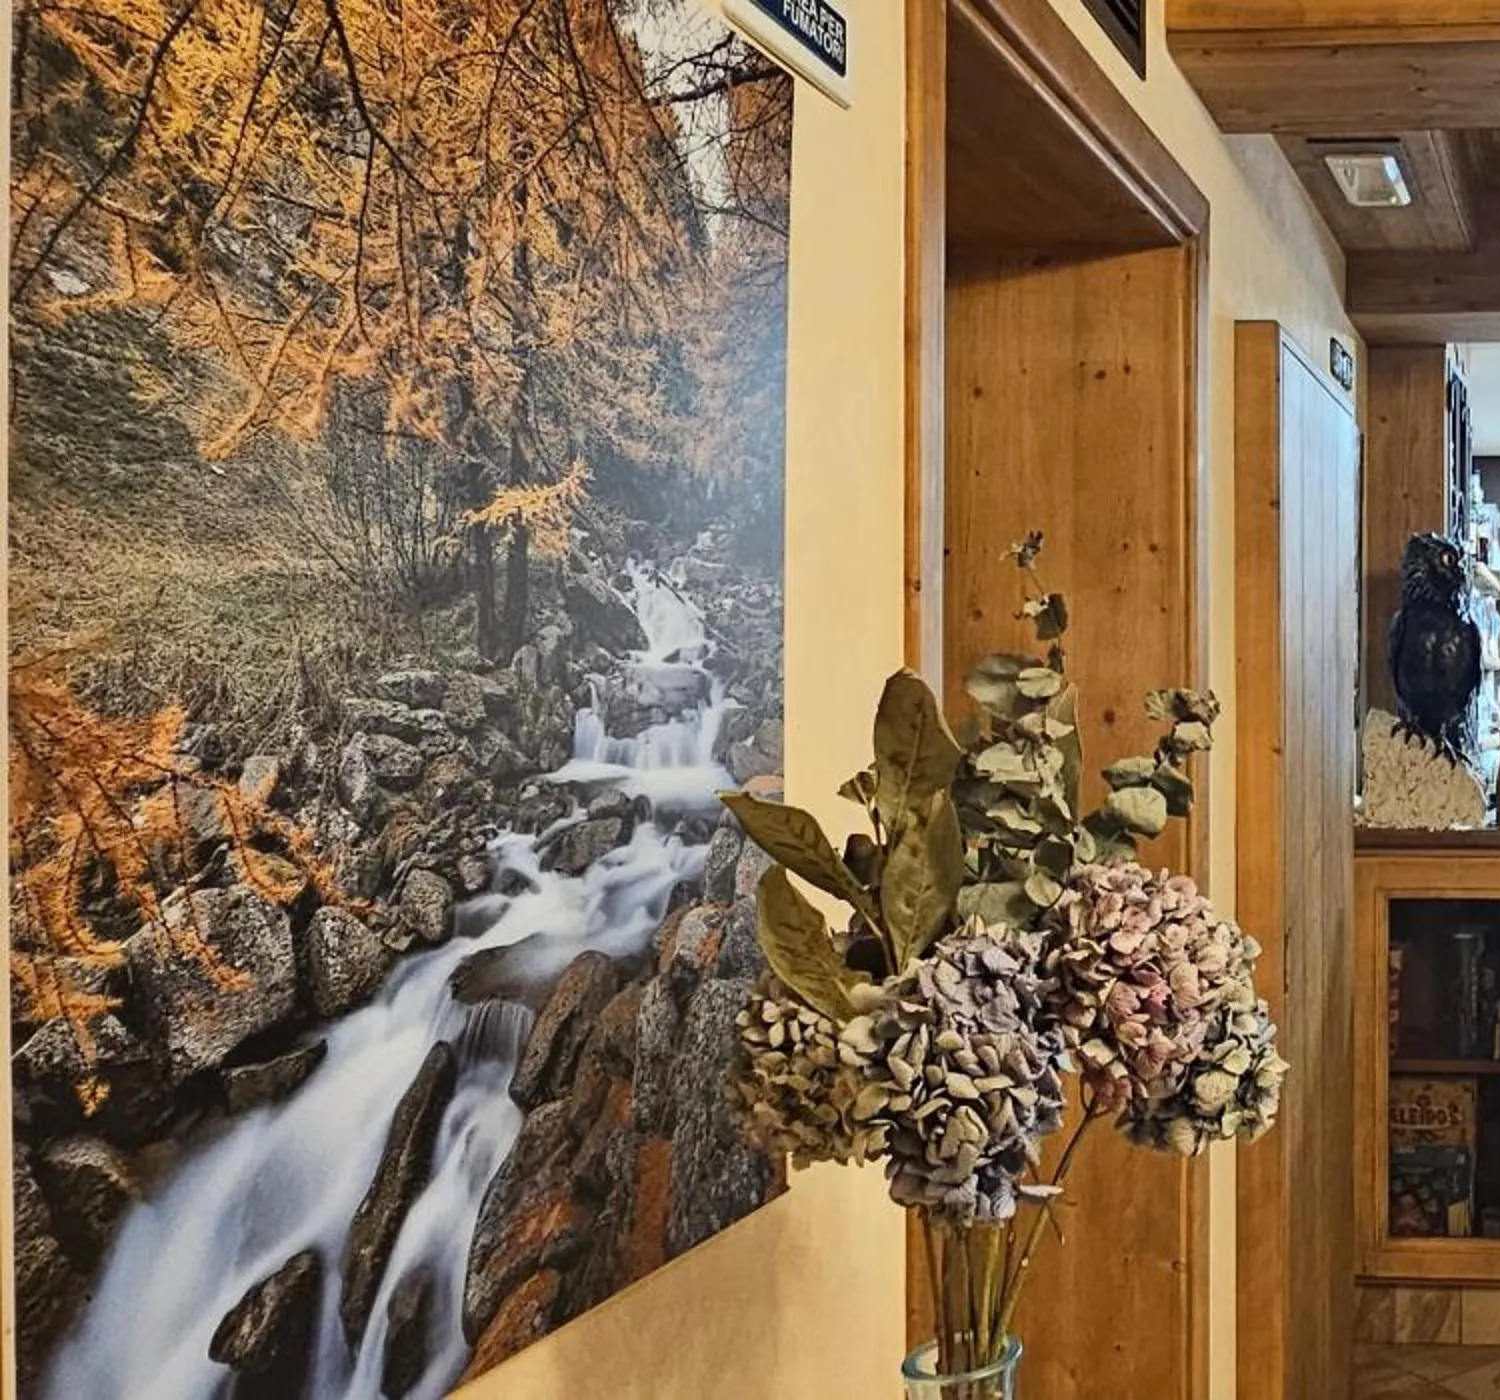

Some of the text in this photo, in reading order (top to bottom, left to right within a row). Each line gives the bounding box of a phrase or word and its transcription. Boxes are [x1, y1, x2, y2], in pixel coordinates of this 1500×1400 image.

[783, 0, 845, 65] FUMATORI
[788, 0, 845, 44] EA PER
[1390, 1101, 1462, 1126] ALEIDOS
